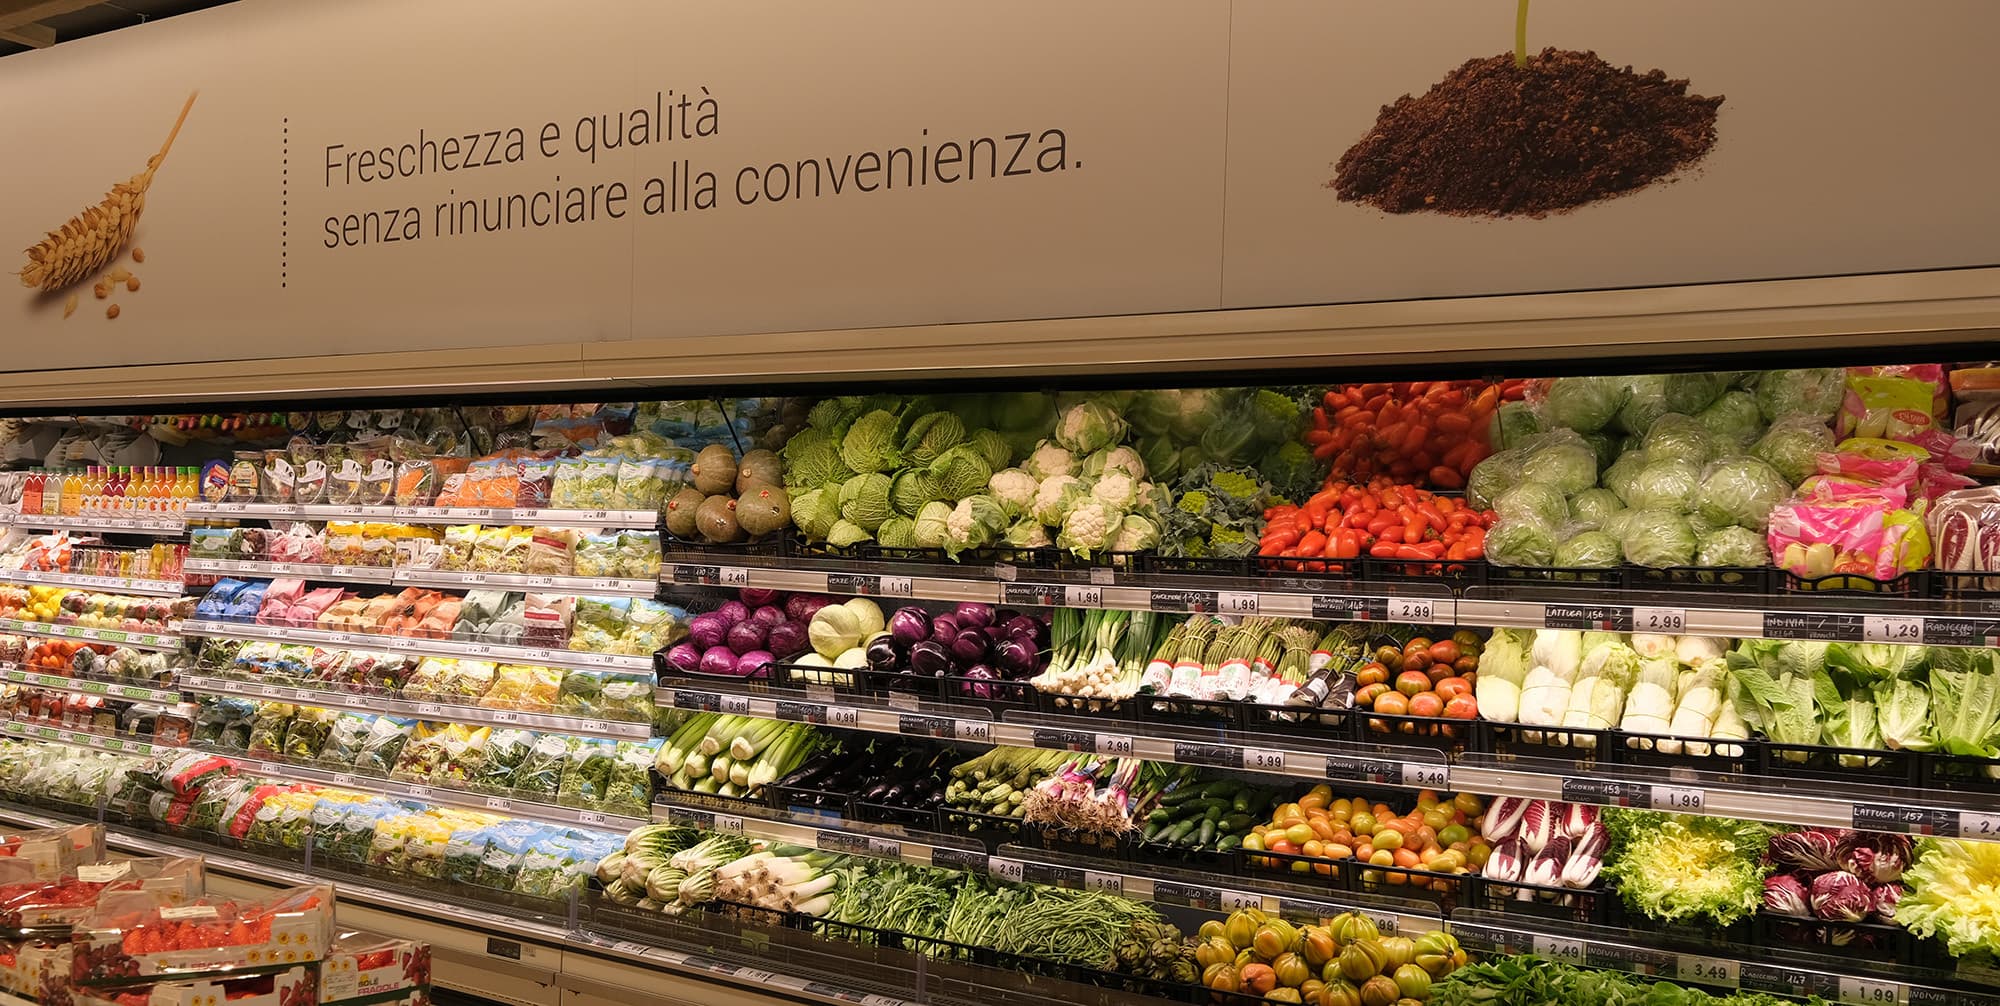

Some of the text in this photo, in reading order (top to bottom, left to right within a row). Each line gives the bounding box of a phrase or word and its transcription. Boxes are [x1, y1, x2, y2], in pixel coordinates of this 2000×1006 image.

[325, 85, 719, 188] Freschezza e qualità
[323, 128, 1082, 249] senza rinunciare alla convenienza.
[1402, 604, 1430, 618] 2,99
[1545, 608, 1583, 618] LATTUGA
[1650, 615, 1682, 629] 2,99
[1766, 617, 1805, 628] INDIVIA
[1884, 624, 1919, 639] 1,29
[1416, 770, 1445, 784] 3,49
[1670, 793, 1700, 808] 1,99
[1853, 807, 1895, 819] LATTUGA
[1549, 943, 1579, 959] 2,49
[1694, 963, 1727, 980] 3,49
[357, 982, 400, 996] FRAGOLE
[1860, 986, 1894, 1003] 1,99
